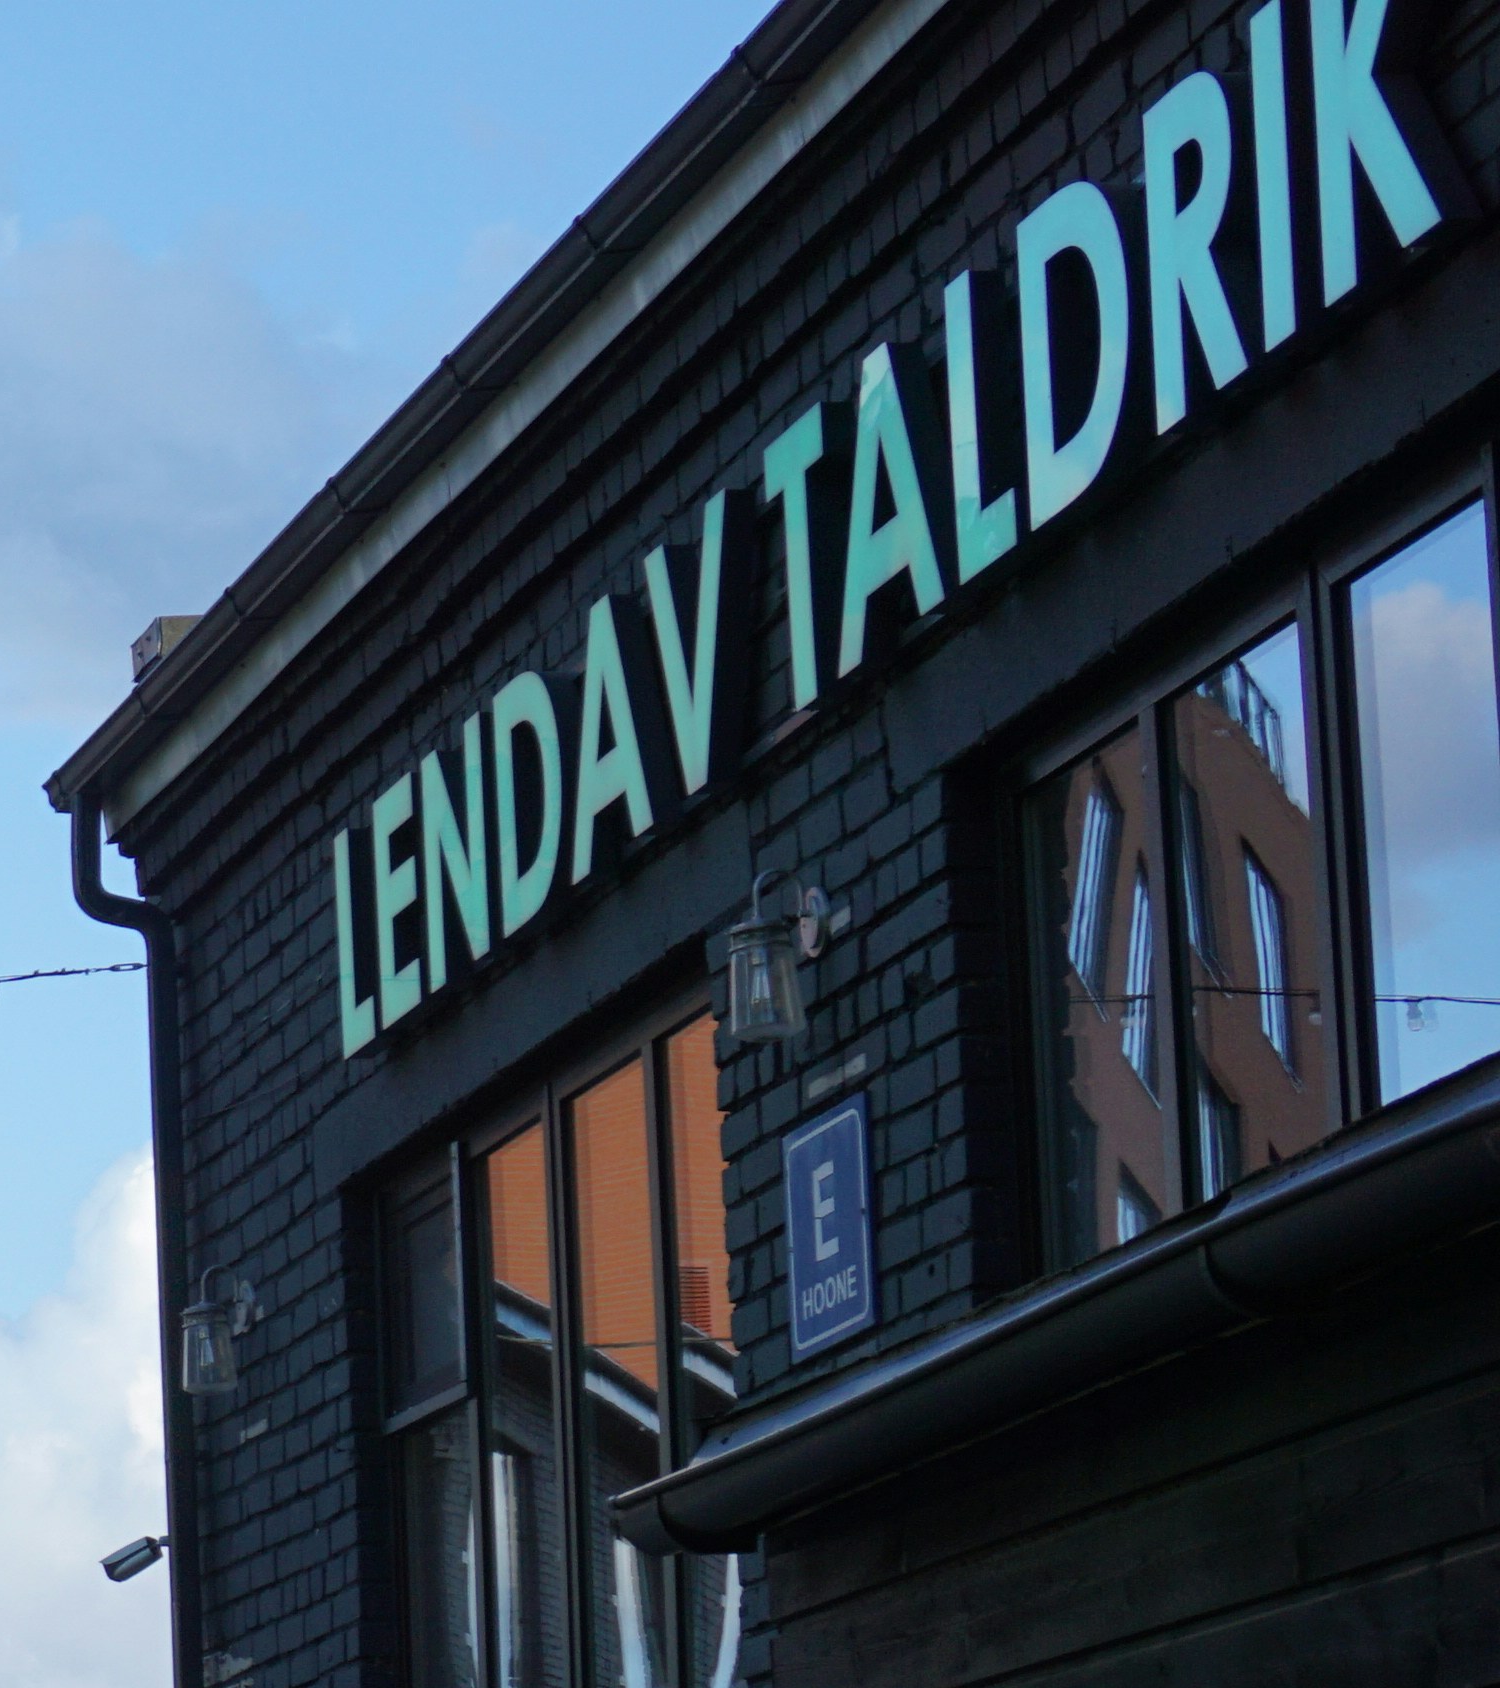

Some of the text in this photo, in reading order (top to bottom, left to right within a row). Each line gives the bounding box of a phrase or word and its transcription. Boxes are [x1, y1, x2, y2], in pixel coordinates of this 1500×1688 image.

[332, 0, 1442, 1061] LENDAV TALDRIK
[812, 1160, 840, 1262] E
[803, 1265, 858, 1321] HOONE
